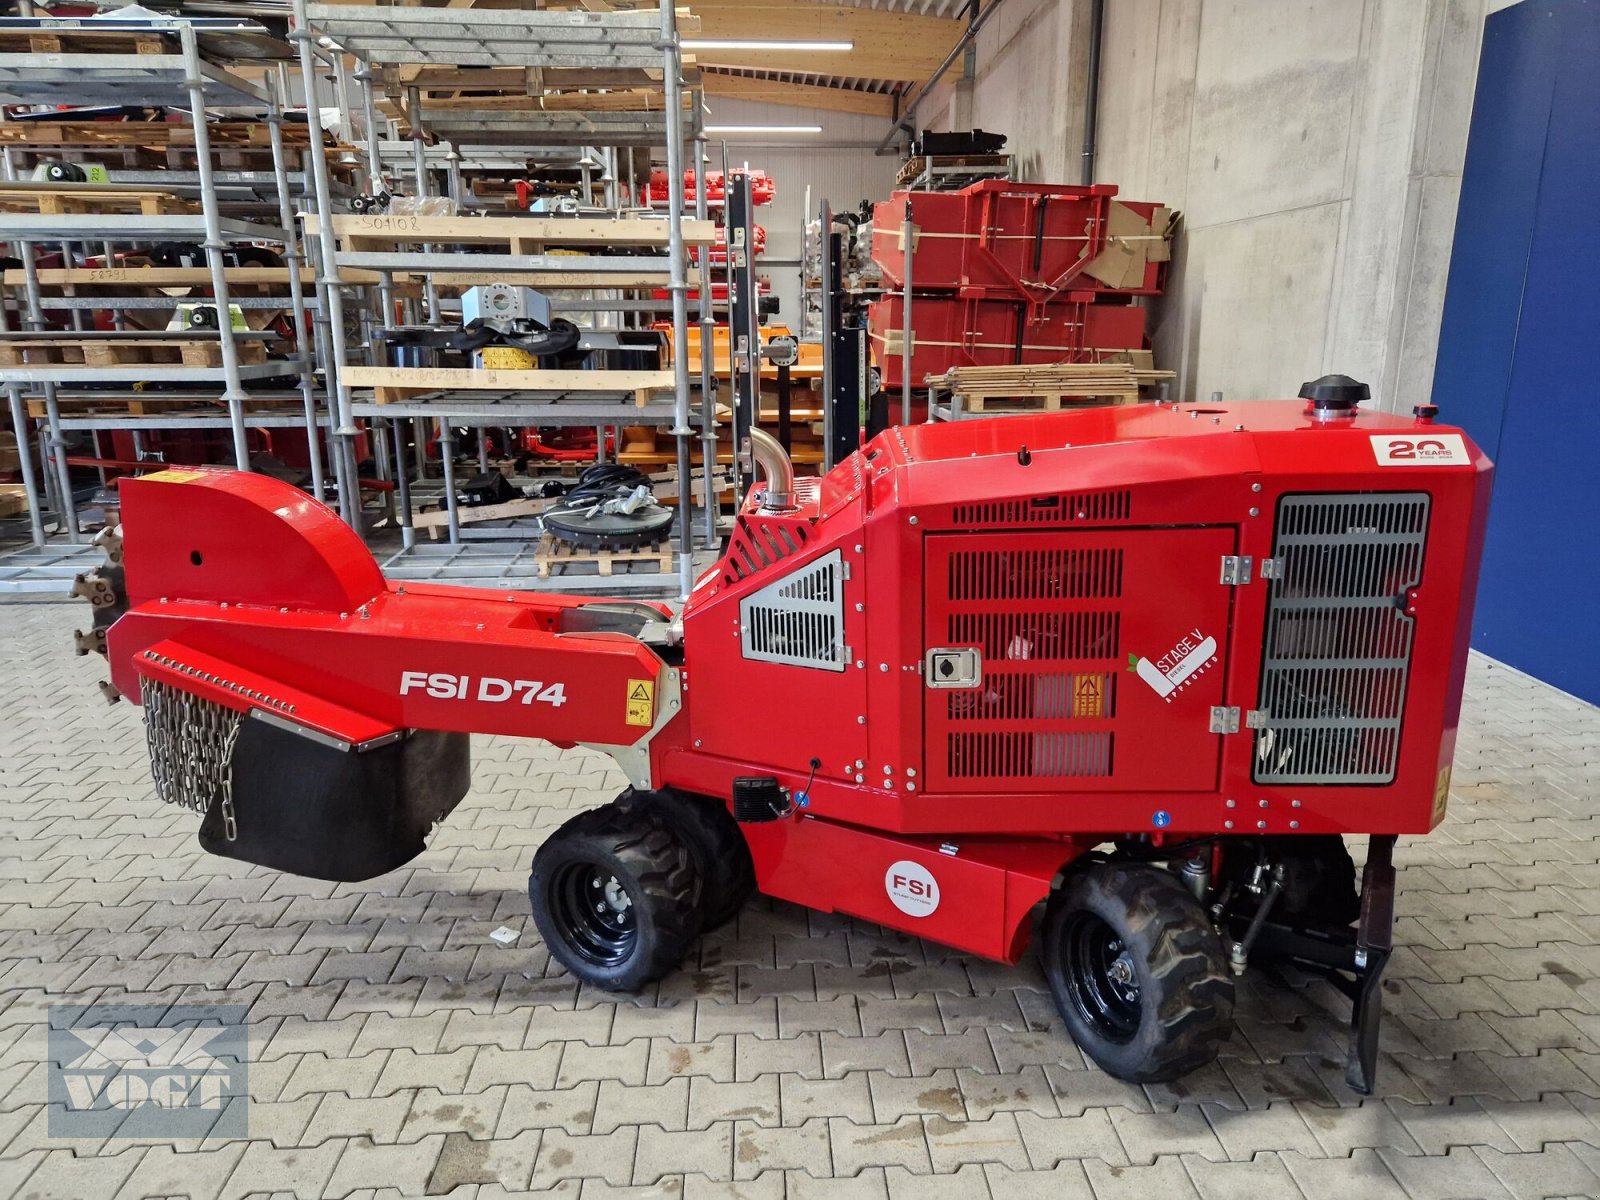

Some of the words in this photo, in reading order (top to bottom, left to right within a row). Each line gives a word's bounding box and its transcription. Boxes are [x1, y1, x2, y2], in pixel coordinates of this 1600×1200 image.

[1156, 636, 1197, 673] STAGE
[1190, 628, 1204, 641] V
[1165, 655, 1218, 704] APPROVED
[1169, 663, 1187, 678] DIESEL
[400, 671, 469, 700] FSI
[478, 677, 567, 707] D74
[893, 874, 932, 899] FSI
